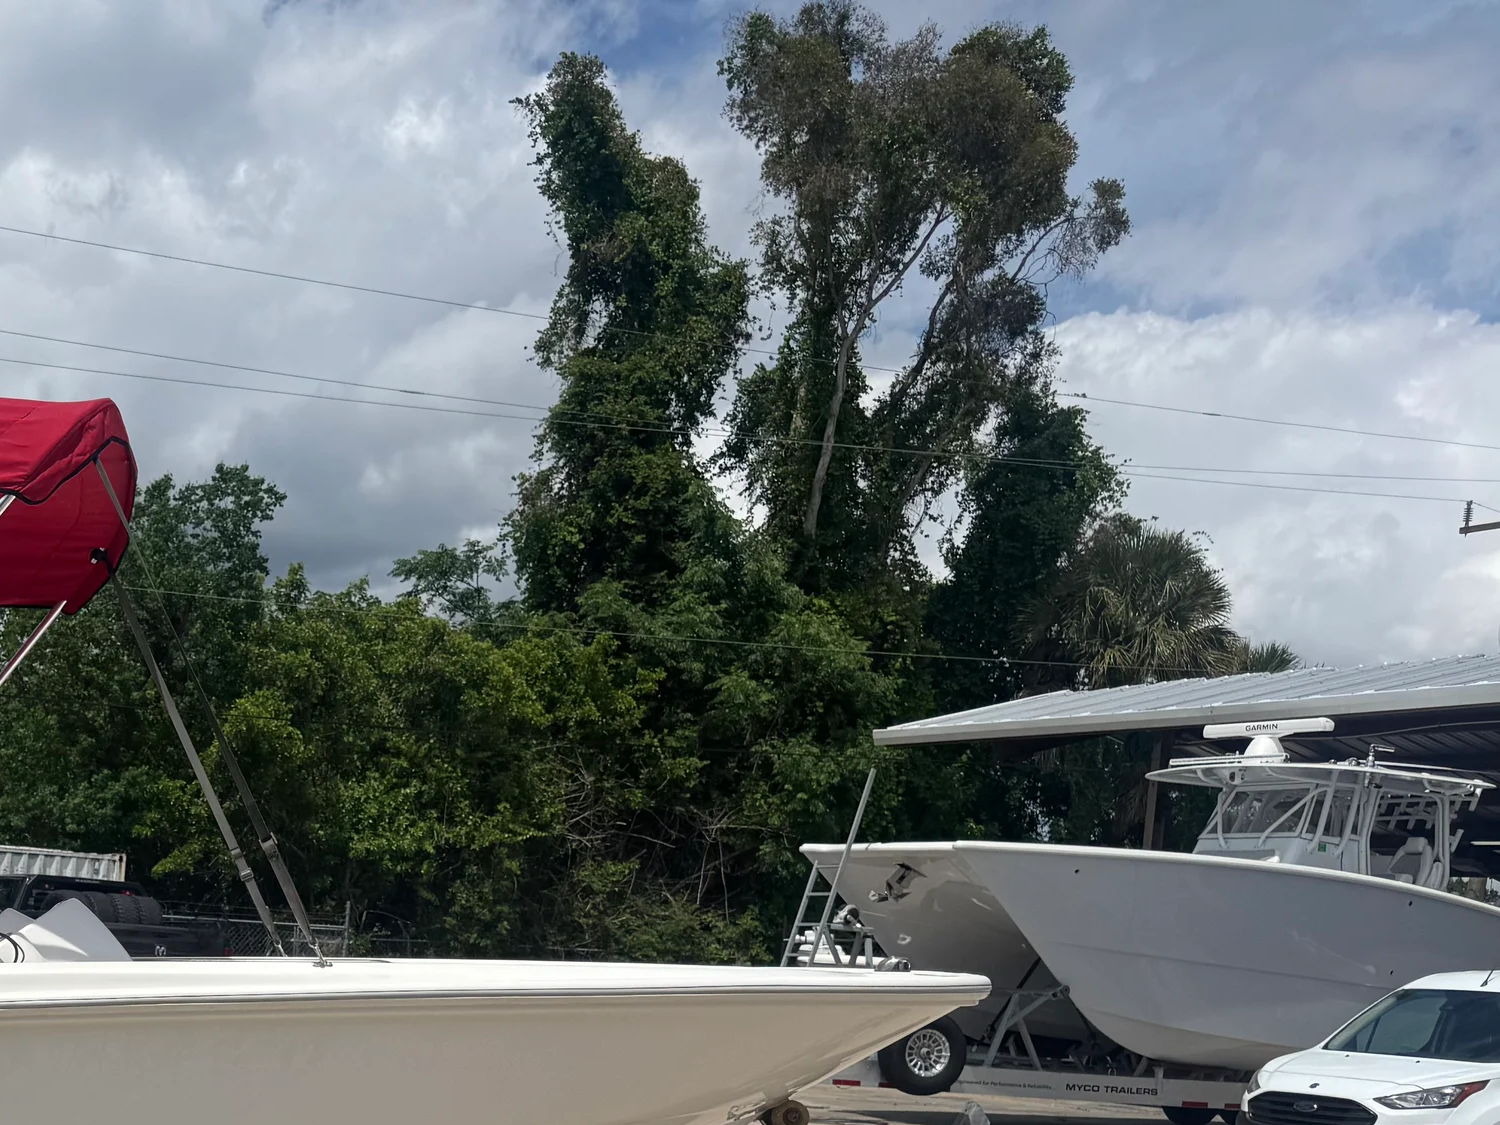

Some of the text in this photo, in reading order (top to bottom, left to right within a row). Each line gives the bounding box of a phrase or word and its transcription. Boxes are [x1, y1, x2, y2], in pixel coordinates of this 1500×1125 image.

[1245, 723, 1278, 731] GARMIN
[1065, 1083, 1158, 1096] MYCO TRAILERS
